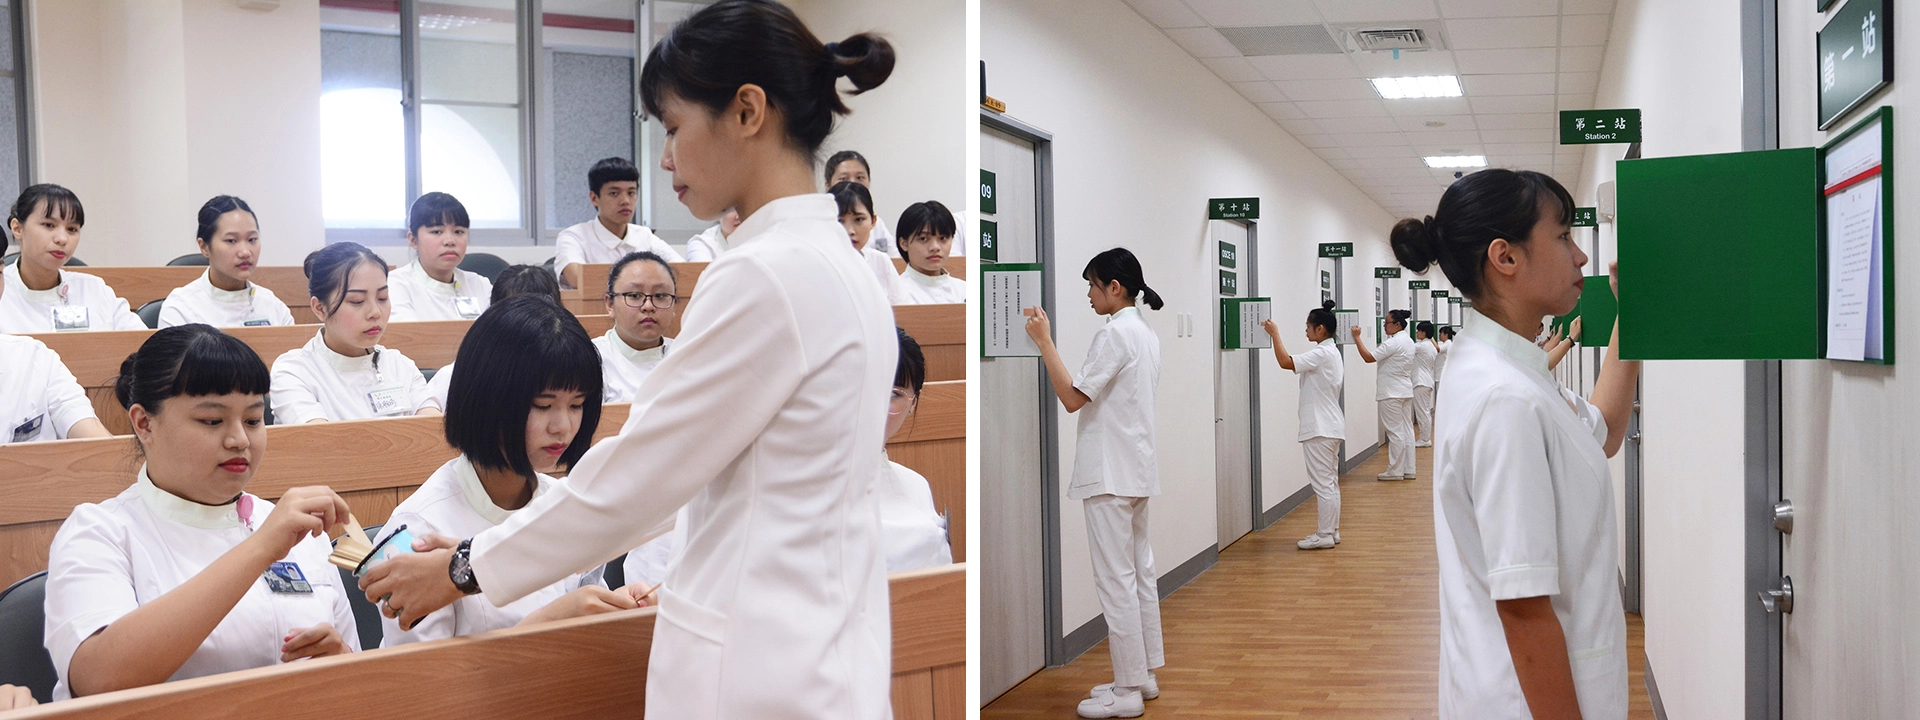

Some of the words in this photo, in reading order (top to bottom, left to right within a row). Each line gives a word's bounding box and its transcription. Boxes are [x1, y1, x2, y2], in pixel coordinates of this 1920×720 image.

[1823, 10, 1876, 93] 第一站
[1575, 117, 1626, 131] 第二站
[1611, 132, 1617, 140] 2
[981, 183, 992, 199] 09
[1218, 203, 1250, 211] 第十站
